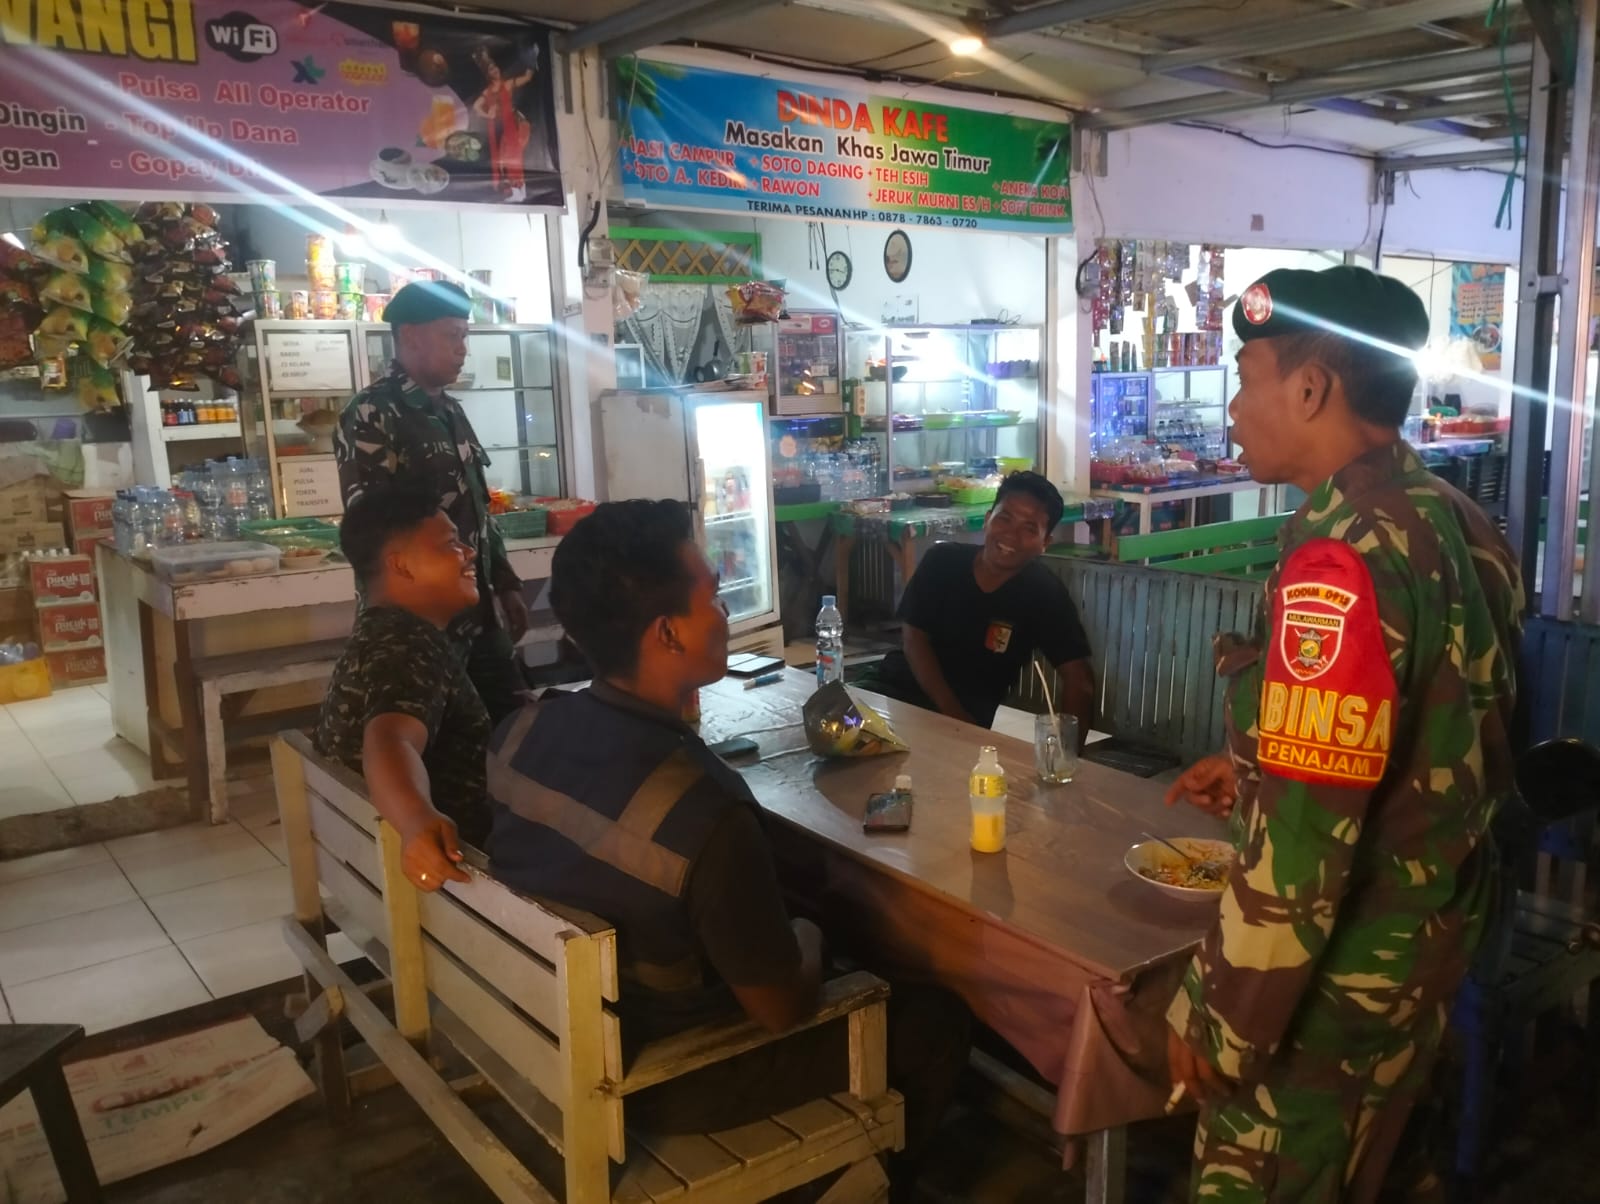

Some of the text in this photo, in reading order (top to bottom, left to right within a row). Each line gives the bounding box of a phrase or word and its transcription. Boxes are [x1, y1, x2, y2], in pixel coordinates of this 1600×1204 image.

[119, 72, 370, 113] Pulsa All Operator
[776, 89, 948, 142] DINDA KAFE
[122, 112, 177, 141] Top
[231, 119, 299, 145] Dana
[669, 144, 736, 168] CAMPUR
[724, 120, 991, 174] Masakan Khas Jawa Timur
[128, 151, 216, 181] Gopay
[761, 156, 864, 181] SOTO DAGING
[875, 167, 899, 185] TEH
[761, 177, 821, 197] RAWON
[875, 188, 913, 205] JERUK
[918, 192, 960, 209] MURNI
[747, 200, 978, 229] TERIMA PESANAN HP 0878 7863 0720
[1029, 202, 1068, 217] DRINK
[1286, 587, 1321, 601] KODIM
[1288, 613, 1340, 628] MULAWARMAN
[1267, 741, 1370, 776] PENAJAM
